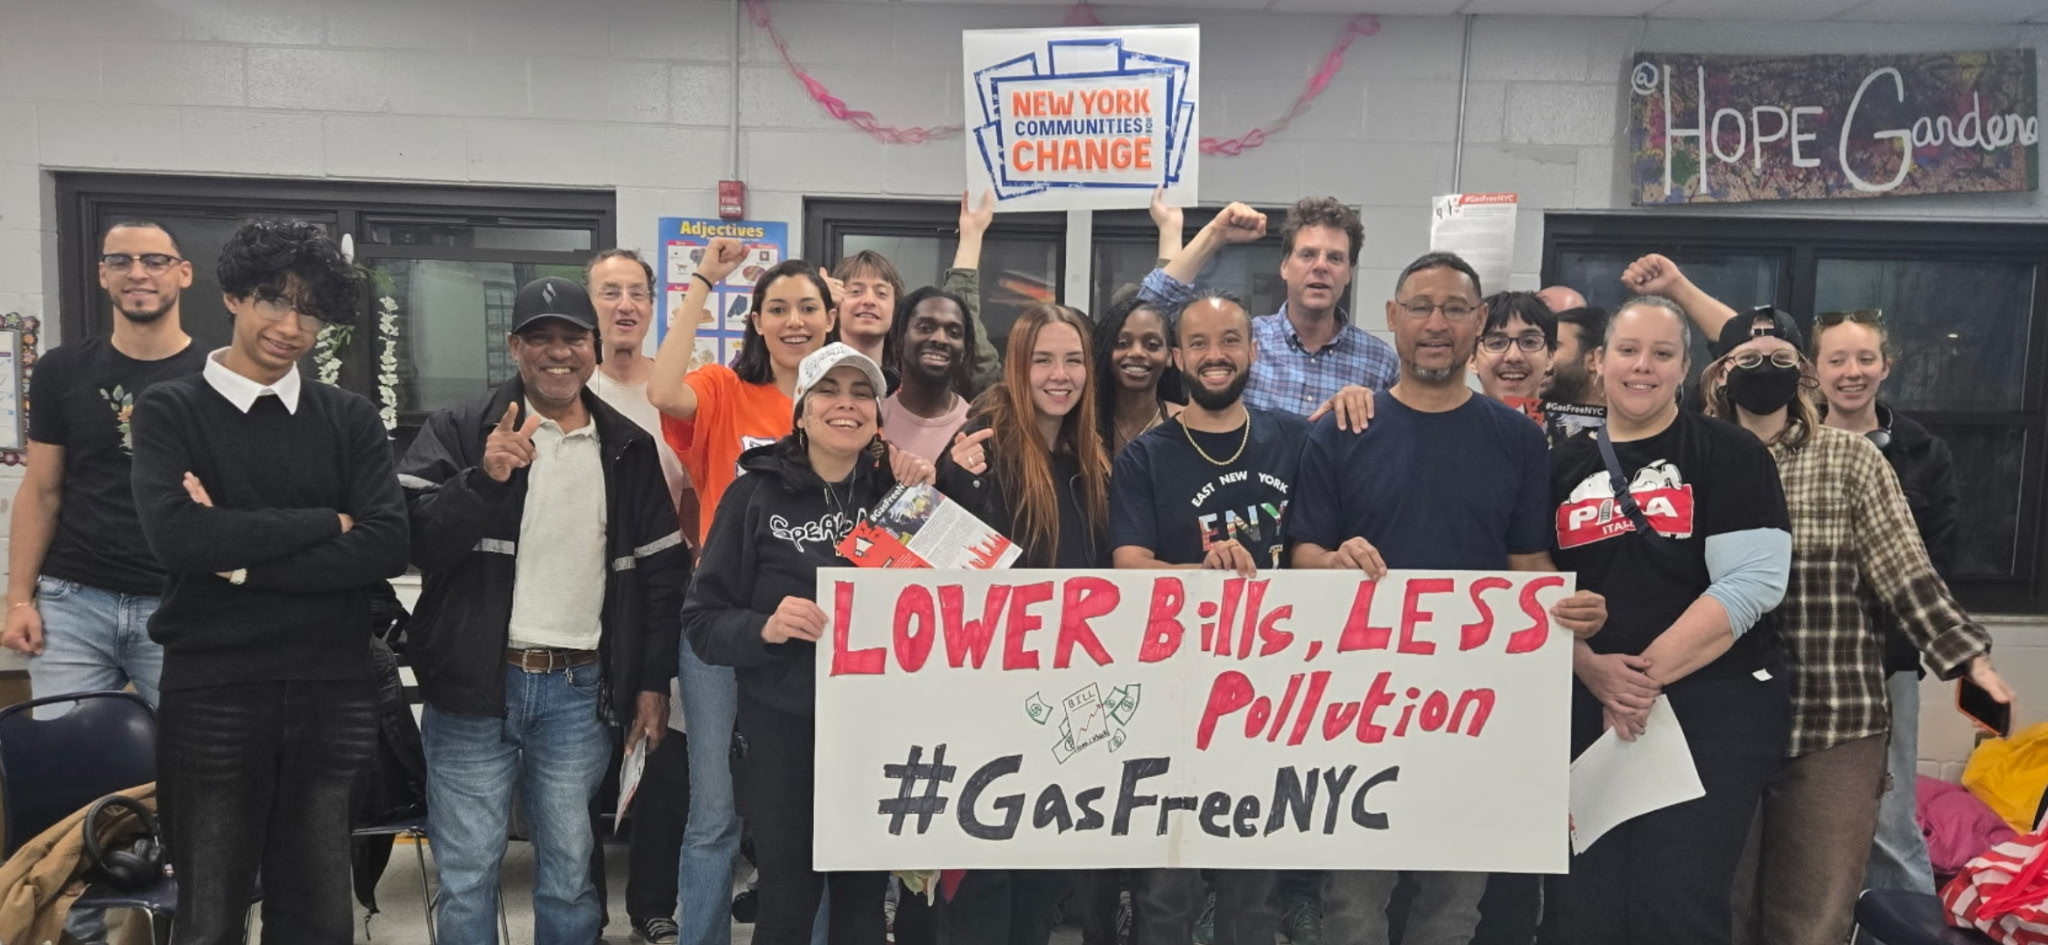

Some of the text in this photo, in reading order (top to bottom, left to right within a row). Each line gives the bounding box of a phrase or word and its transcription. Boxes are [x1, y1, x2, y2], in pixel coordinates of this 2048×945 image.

[1013, 88, 1151, 117] NEW YORK
[1015, 117, 1143, 136] COMMUNITIES
[1145, 117, 1153, 133] FOR
[1013, 136, 1152, 172] CHANGE
[680, 221, 764, 238] Adjectives
[1545, 402, 1605, 416] #GasFreeNYC
[870, 483, 907, 523] #GasFreeN
[1191, 470, 1288, 507] EAST NEW YORK
[830, 576, 1566, 677] LOWER Bills, LESS
[1068, 690, 1096, 709] BILL
[1196, 670, 1496, 751] Pollution
[878, 743, 1400, 841] #GasFreeNYC
